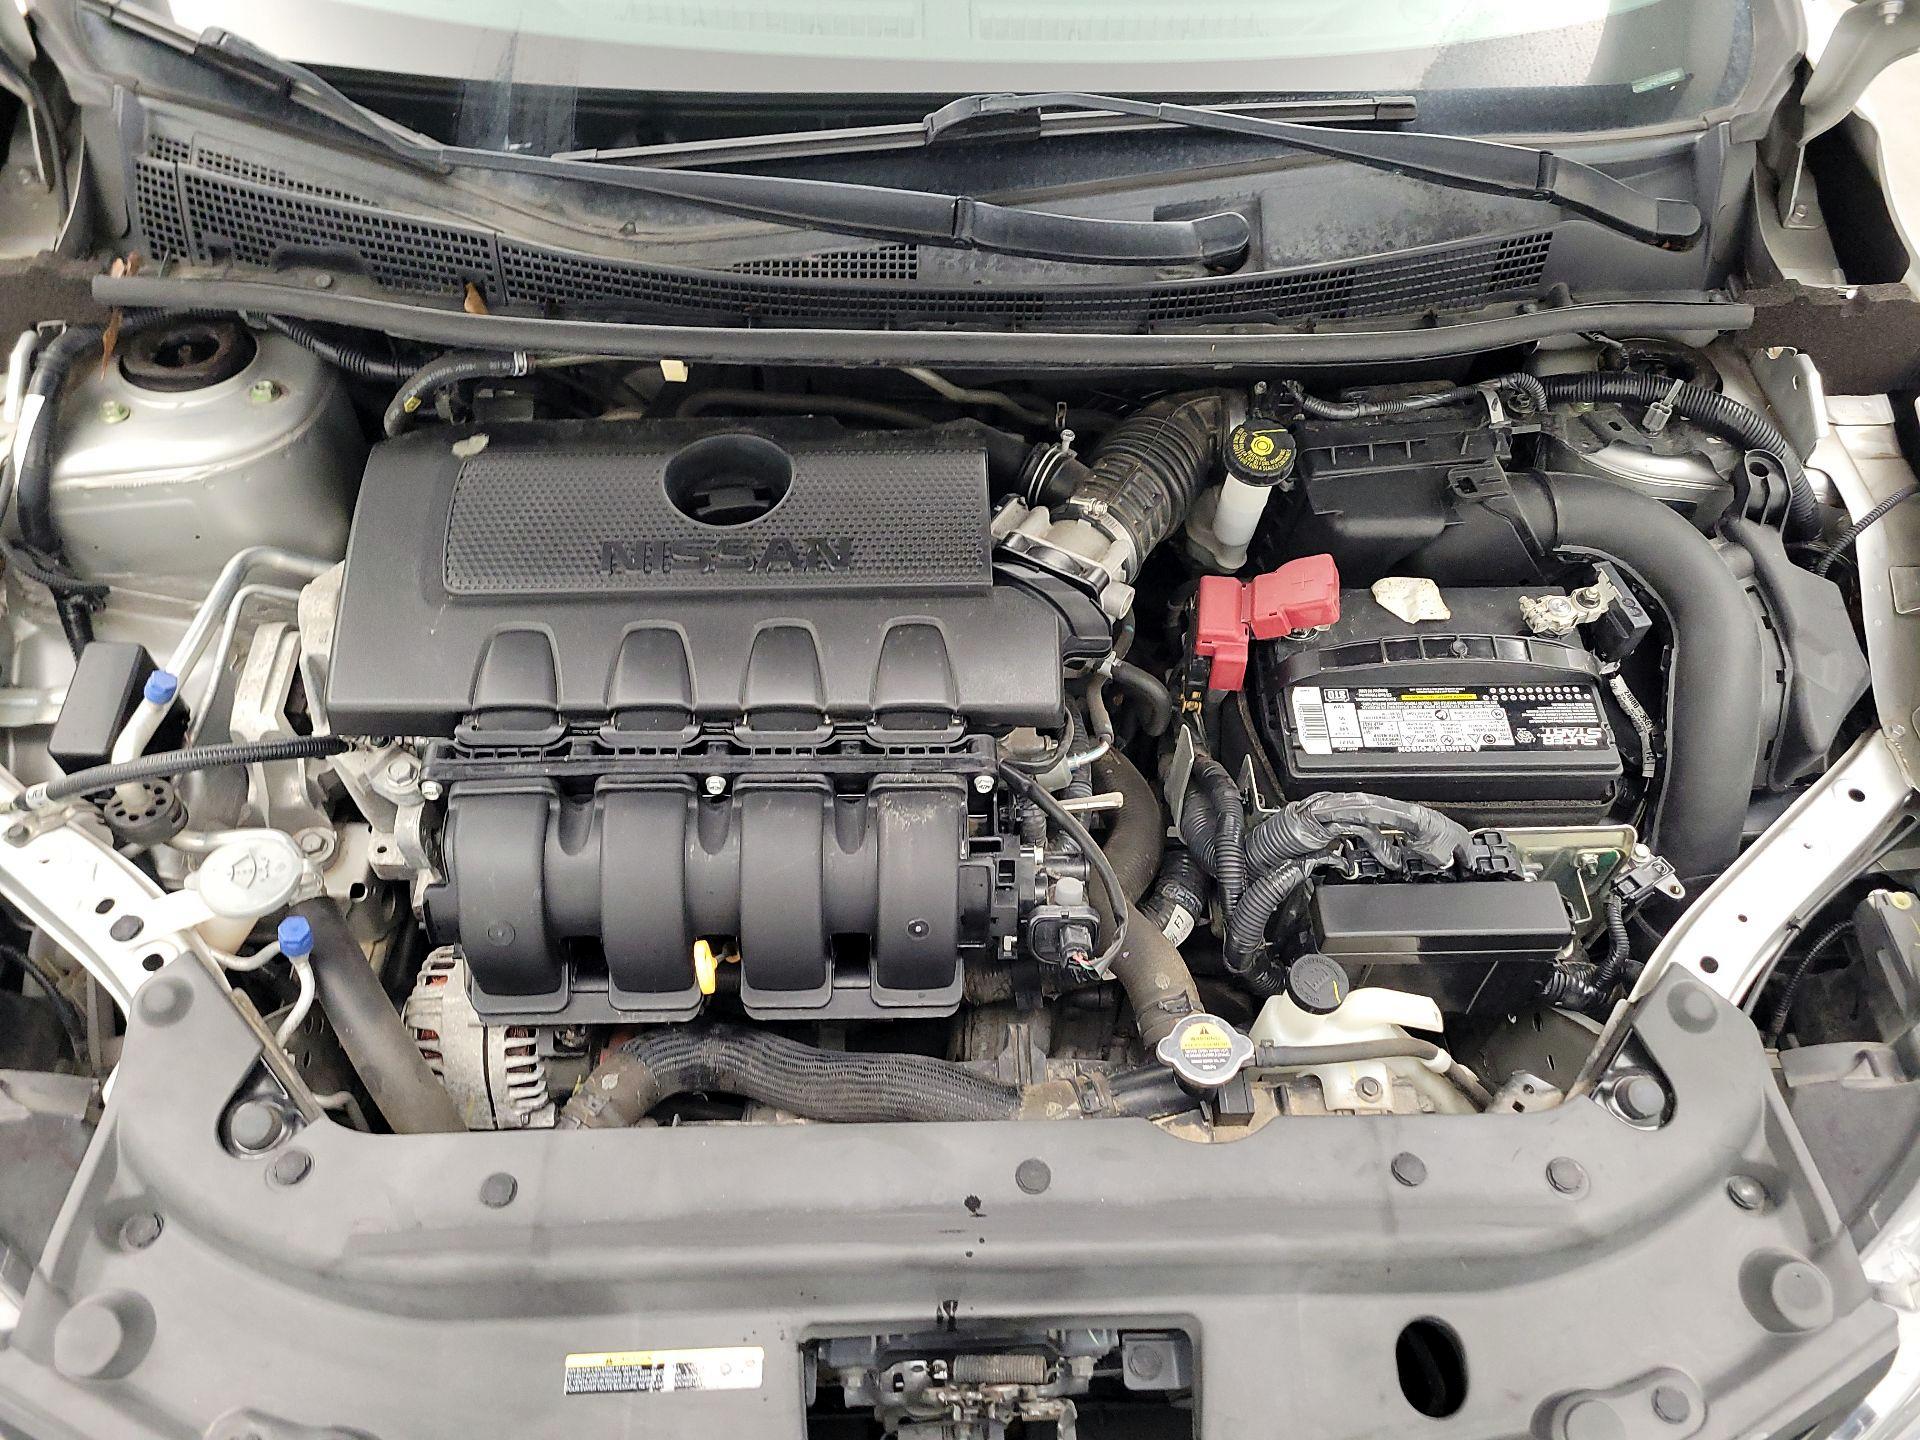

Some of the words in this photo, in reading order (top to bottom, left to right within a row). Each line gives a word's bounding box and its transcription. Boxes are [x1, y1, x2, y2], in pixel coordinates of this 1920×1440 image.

[600, 538, 850, 573] NISSAN
[1542, 737, 1598, 746] SUPER
[1173, 914, 1185, 930] F7
